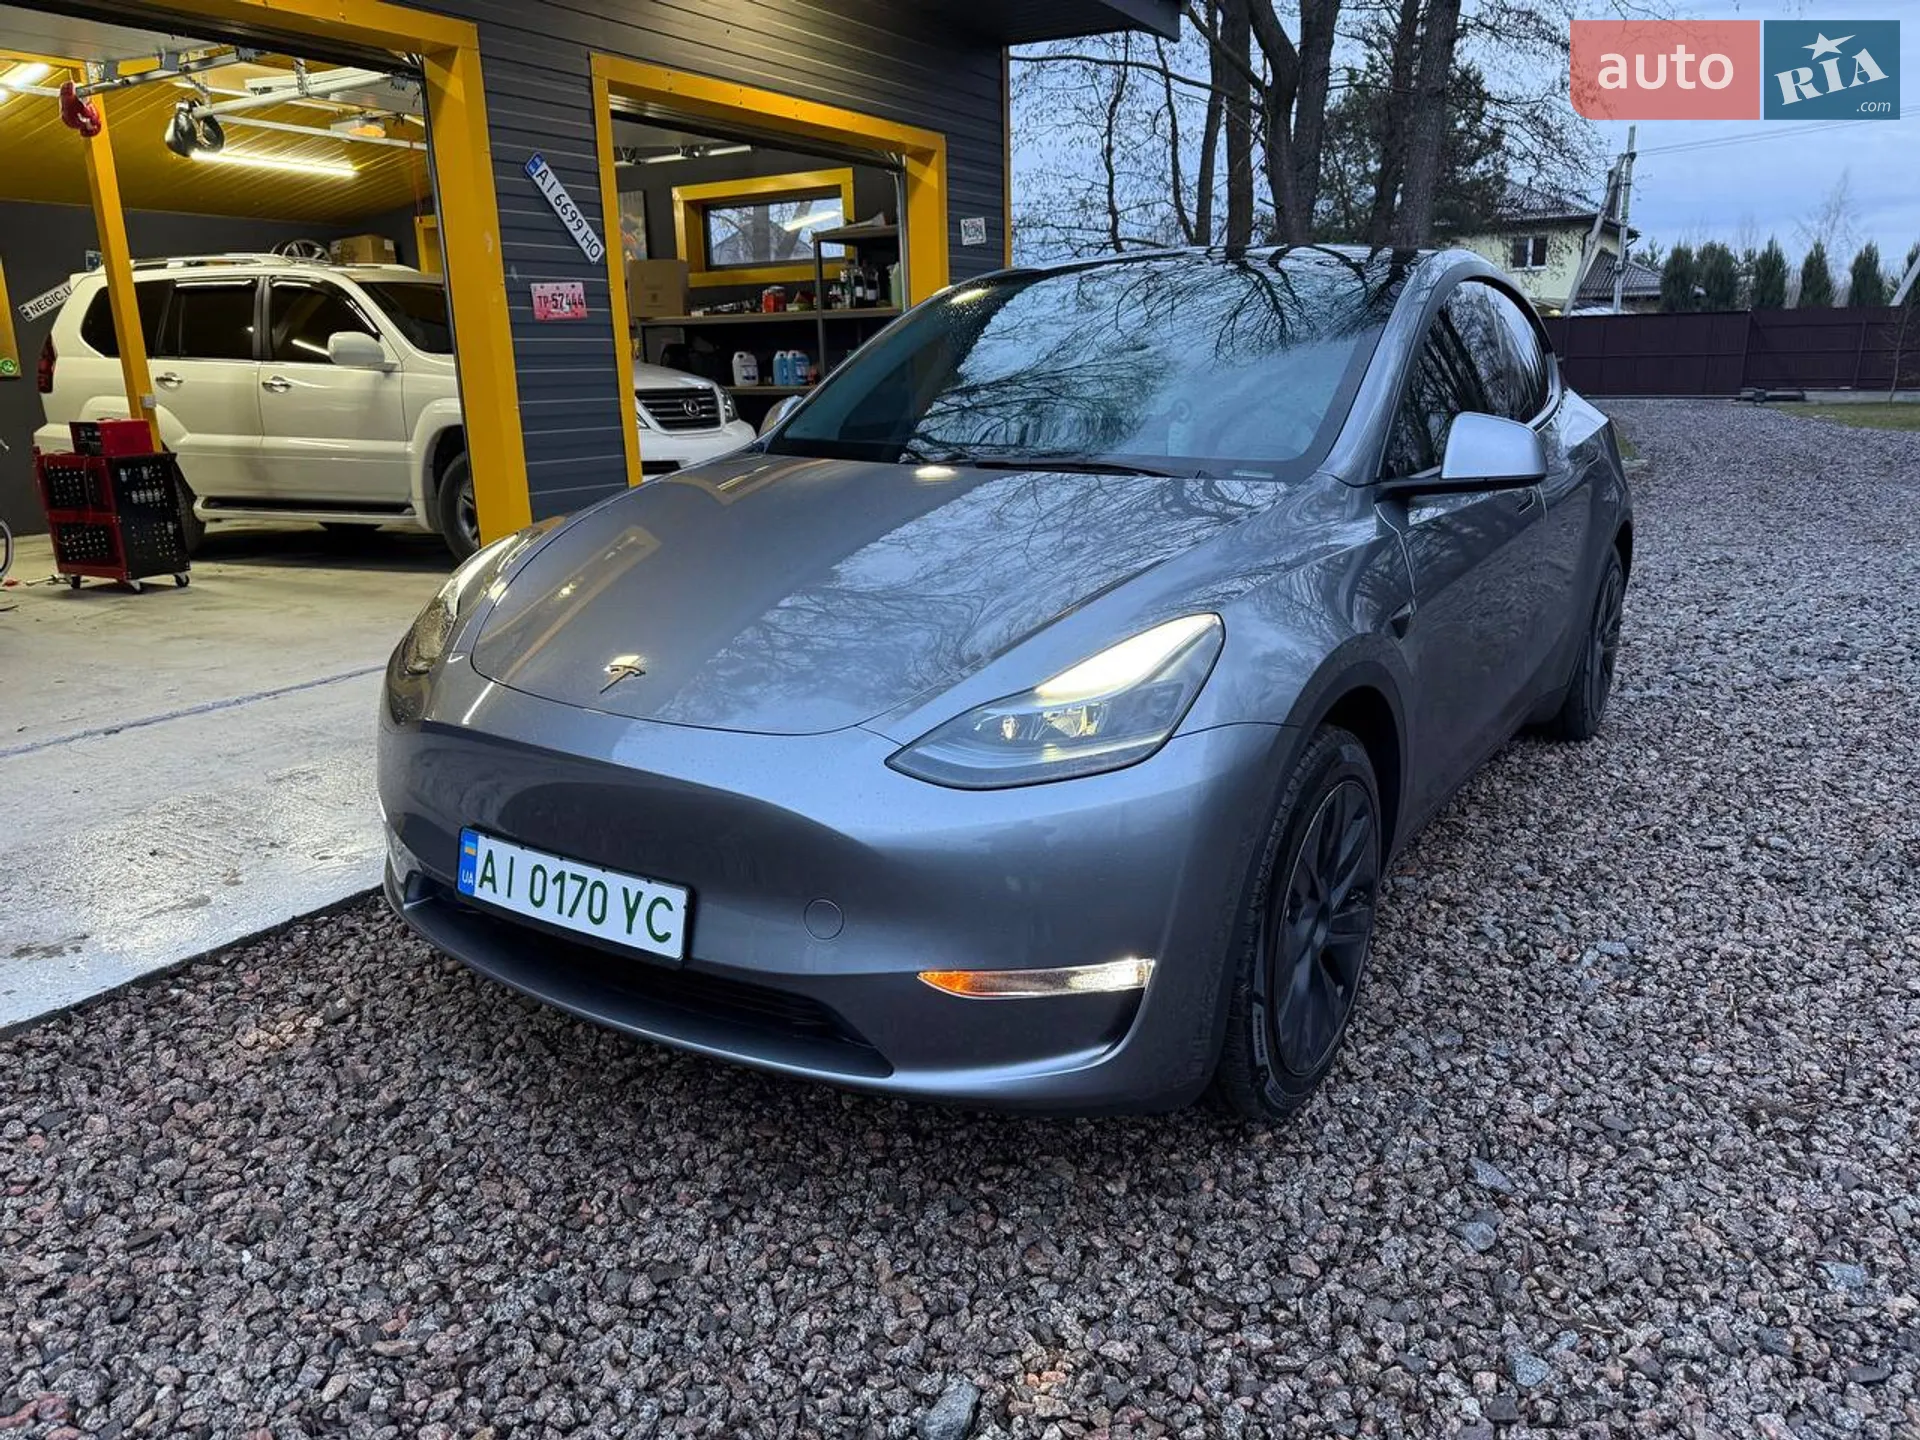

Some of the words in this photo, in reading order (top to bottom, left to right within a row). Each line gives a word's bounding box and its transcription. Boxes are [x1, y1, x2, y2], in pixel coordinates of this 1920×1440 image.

[536, 169, 556, 193] AI
[553, 193, 584, 232] 6699
[580, 231, 601, 259] HO
[462, 869, 474, 886] UA
[479, 849, 515, 899] AI
[529, 864, 608, 926] 0170
[622, 886, 674, 943] YC
